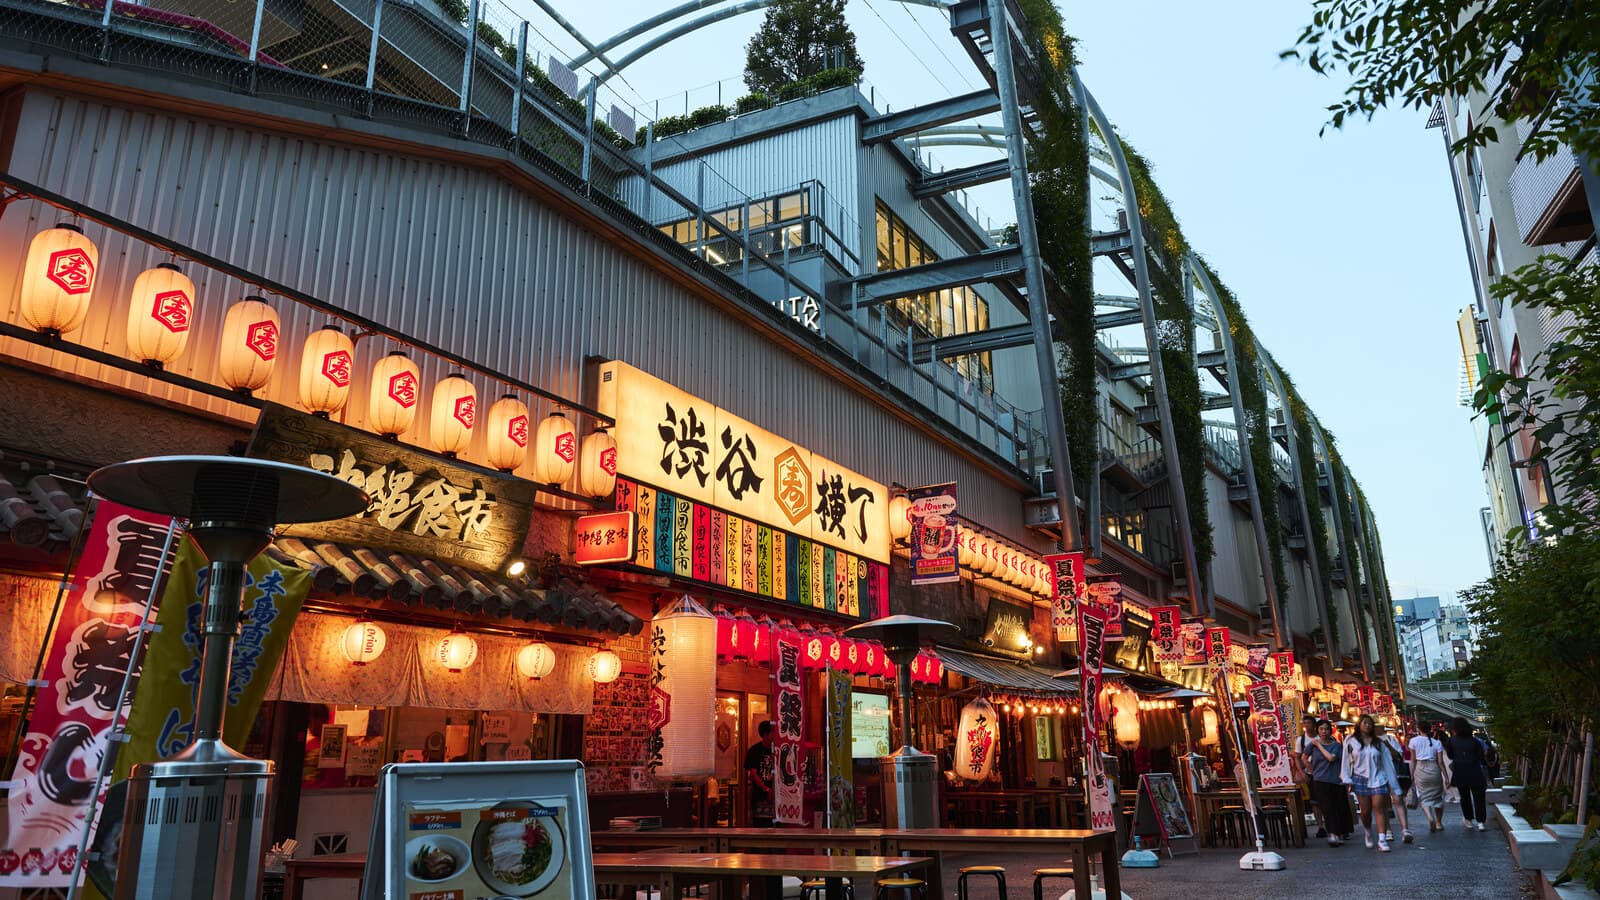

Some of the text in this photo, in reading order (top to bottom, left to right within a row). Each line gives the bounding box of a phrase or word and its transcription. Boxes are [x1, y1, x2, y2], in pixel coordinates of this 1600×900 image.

[771, 296, 818, 313] ITA
[657, 402, 764, 501] 渋谷
[815, 468, 875, 544] 横丁
[577, 527, 628, 547] 沖縄食市
[695, 508, 707, 575] 中国食市
[1056, 559, 1075, 614] 夏祭り
[365, 628, 376, 653] Orion
[440, 640, 449, 663] Orion
[1159, 611, 1173, 652] 夏祭り
[1250, 687, 1280, 767] 夏祭り
